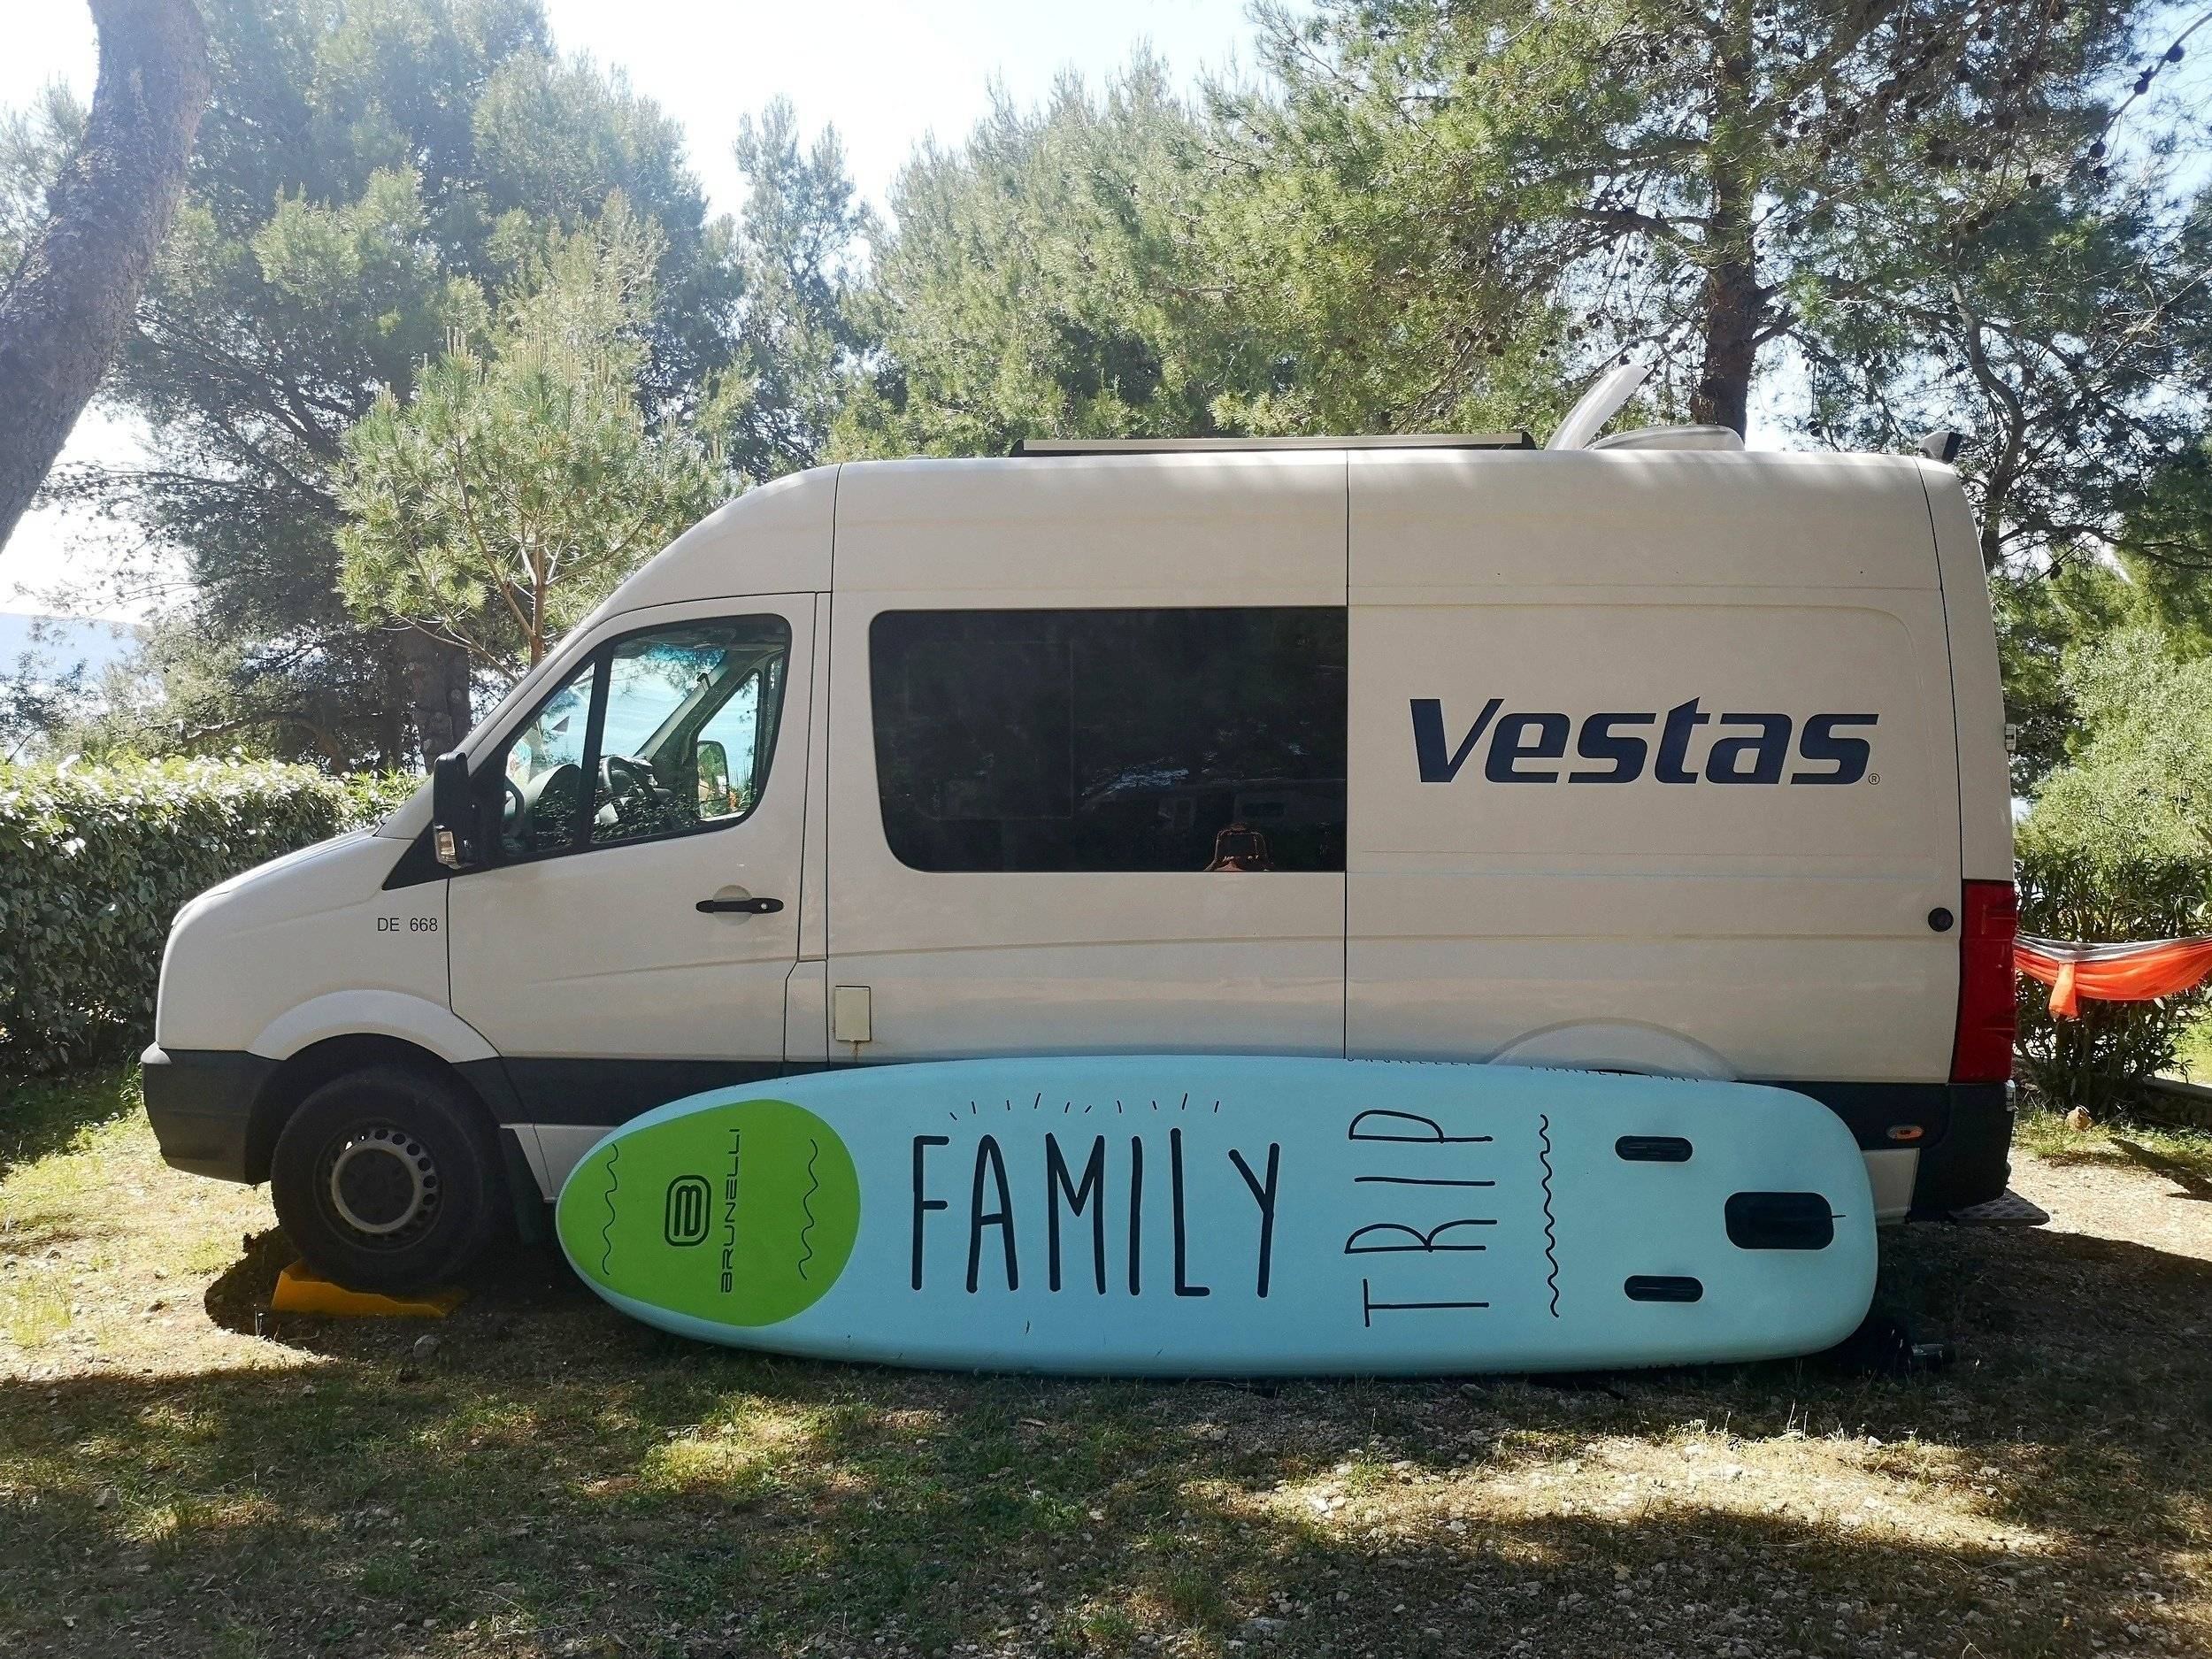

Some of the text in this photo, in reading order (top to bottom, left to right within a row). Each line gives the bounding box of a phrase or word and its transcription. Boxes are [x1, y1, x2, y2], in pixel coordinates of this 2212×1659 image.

[377, 917, 438, 932] DE 668
[720, 1128, 741, 1294] BRUNELLI
[911, 1127, 1280, 1298] FAMILY
[1344, 1109, 1498, 1328] TRIP
